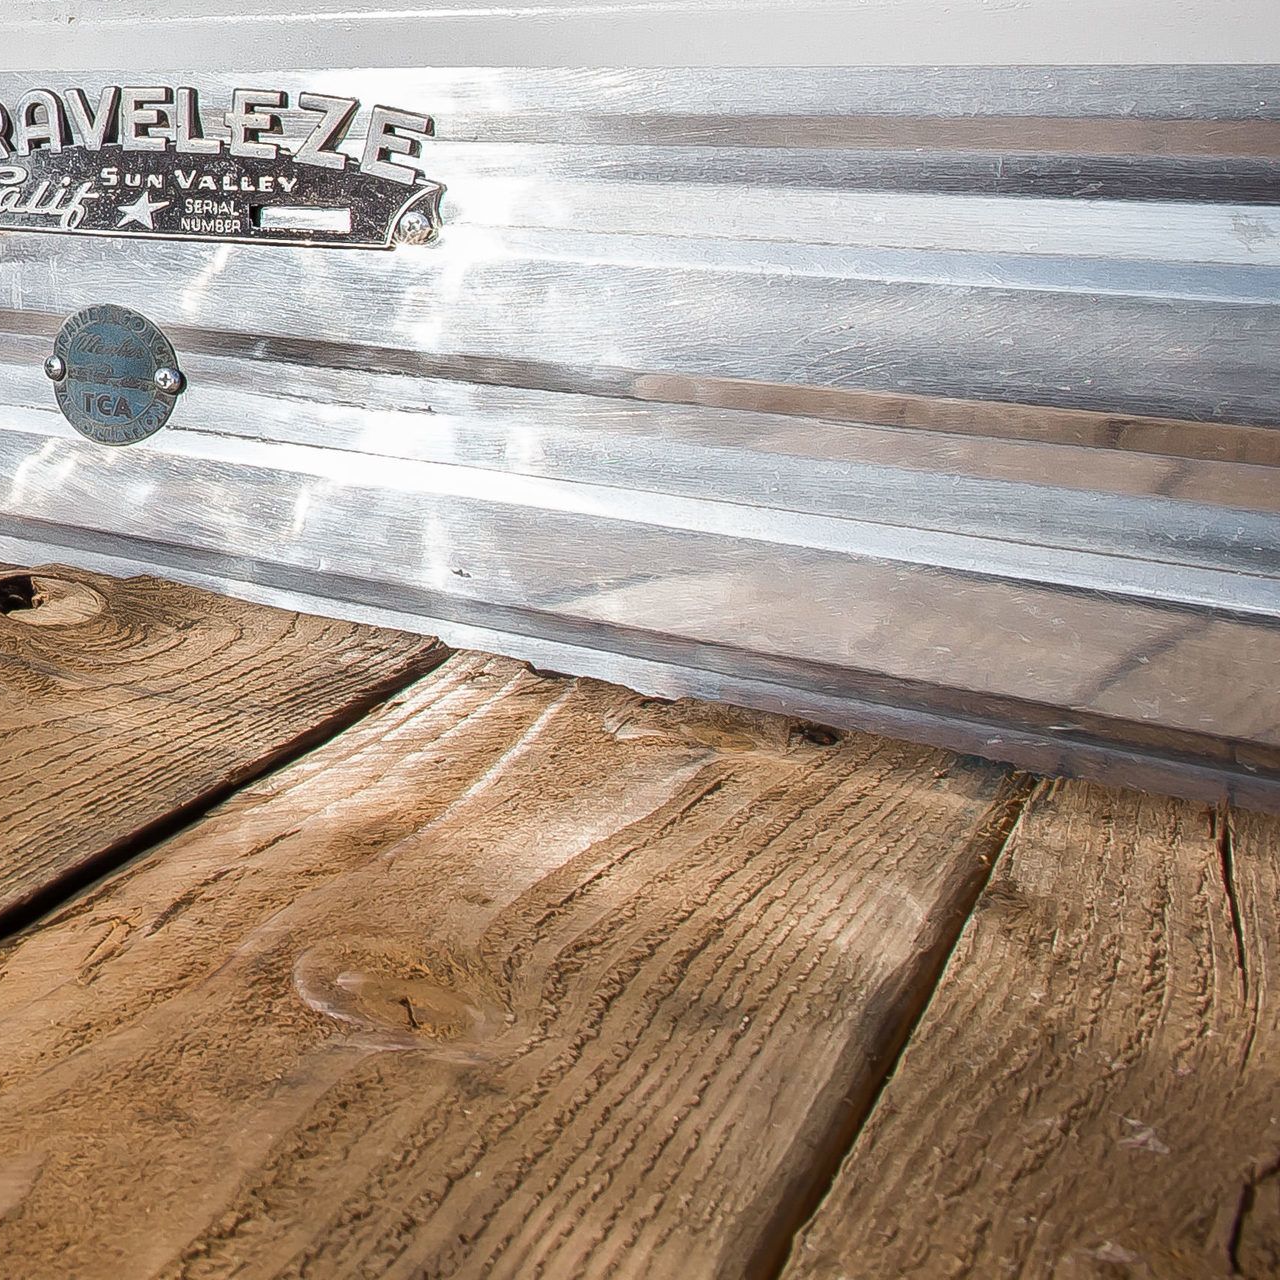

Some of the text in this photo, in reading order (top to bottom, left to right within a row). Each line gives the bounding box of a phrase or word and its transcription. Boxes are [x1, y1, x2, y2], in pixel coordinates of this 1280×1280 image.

[100, 167, 298, 193] SUN VALLEY
[184, 198, 241, 217] SERIAL
[180, 216, 242, 234] NUMBER
[80, 391, 133, 421] TCA
